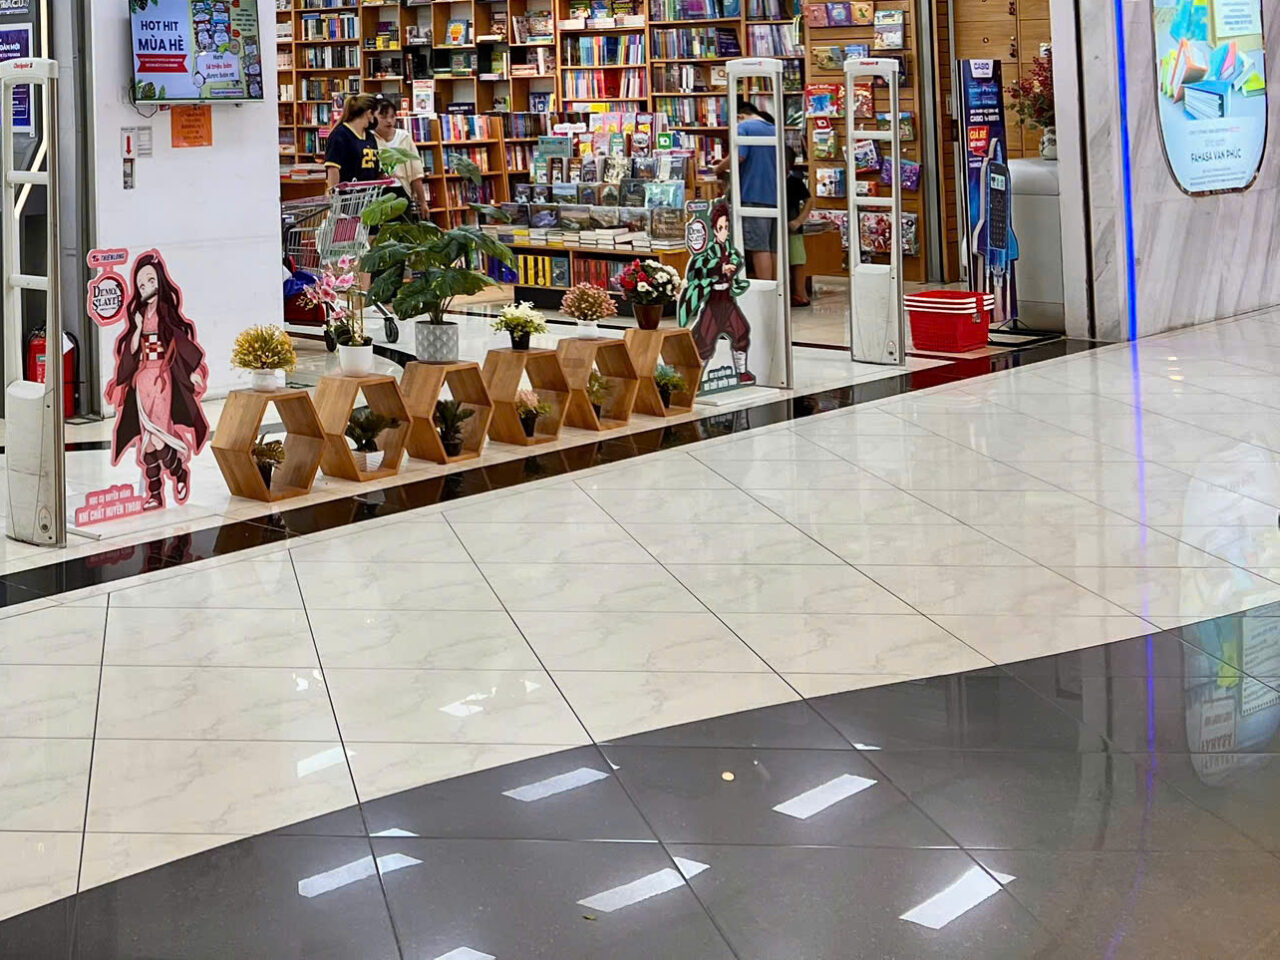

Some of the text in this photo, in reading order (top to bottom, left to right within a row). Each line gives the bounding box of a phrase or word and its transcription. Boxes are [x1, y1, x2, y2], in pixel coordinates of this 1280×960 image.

[140, 20, 179, 32] HOT HIT
[138, 34, 185, 51] MÙA HÈ
[974, 62, 990, 71] CASIO
